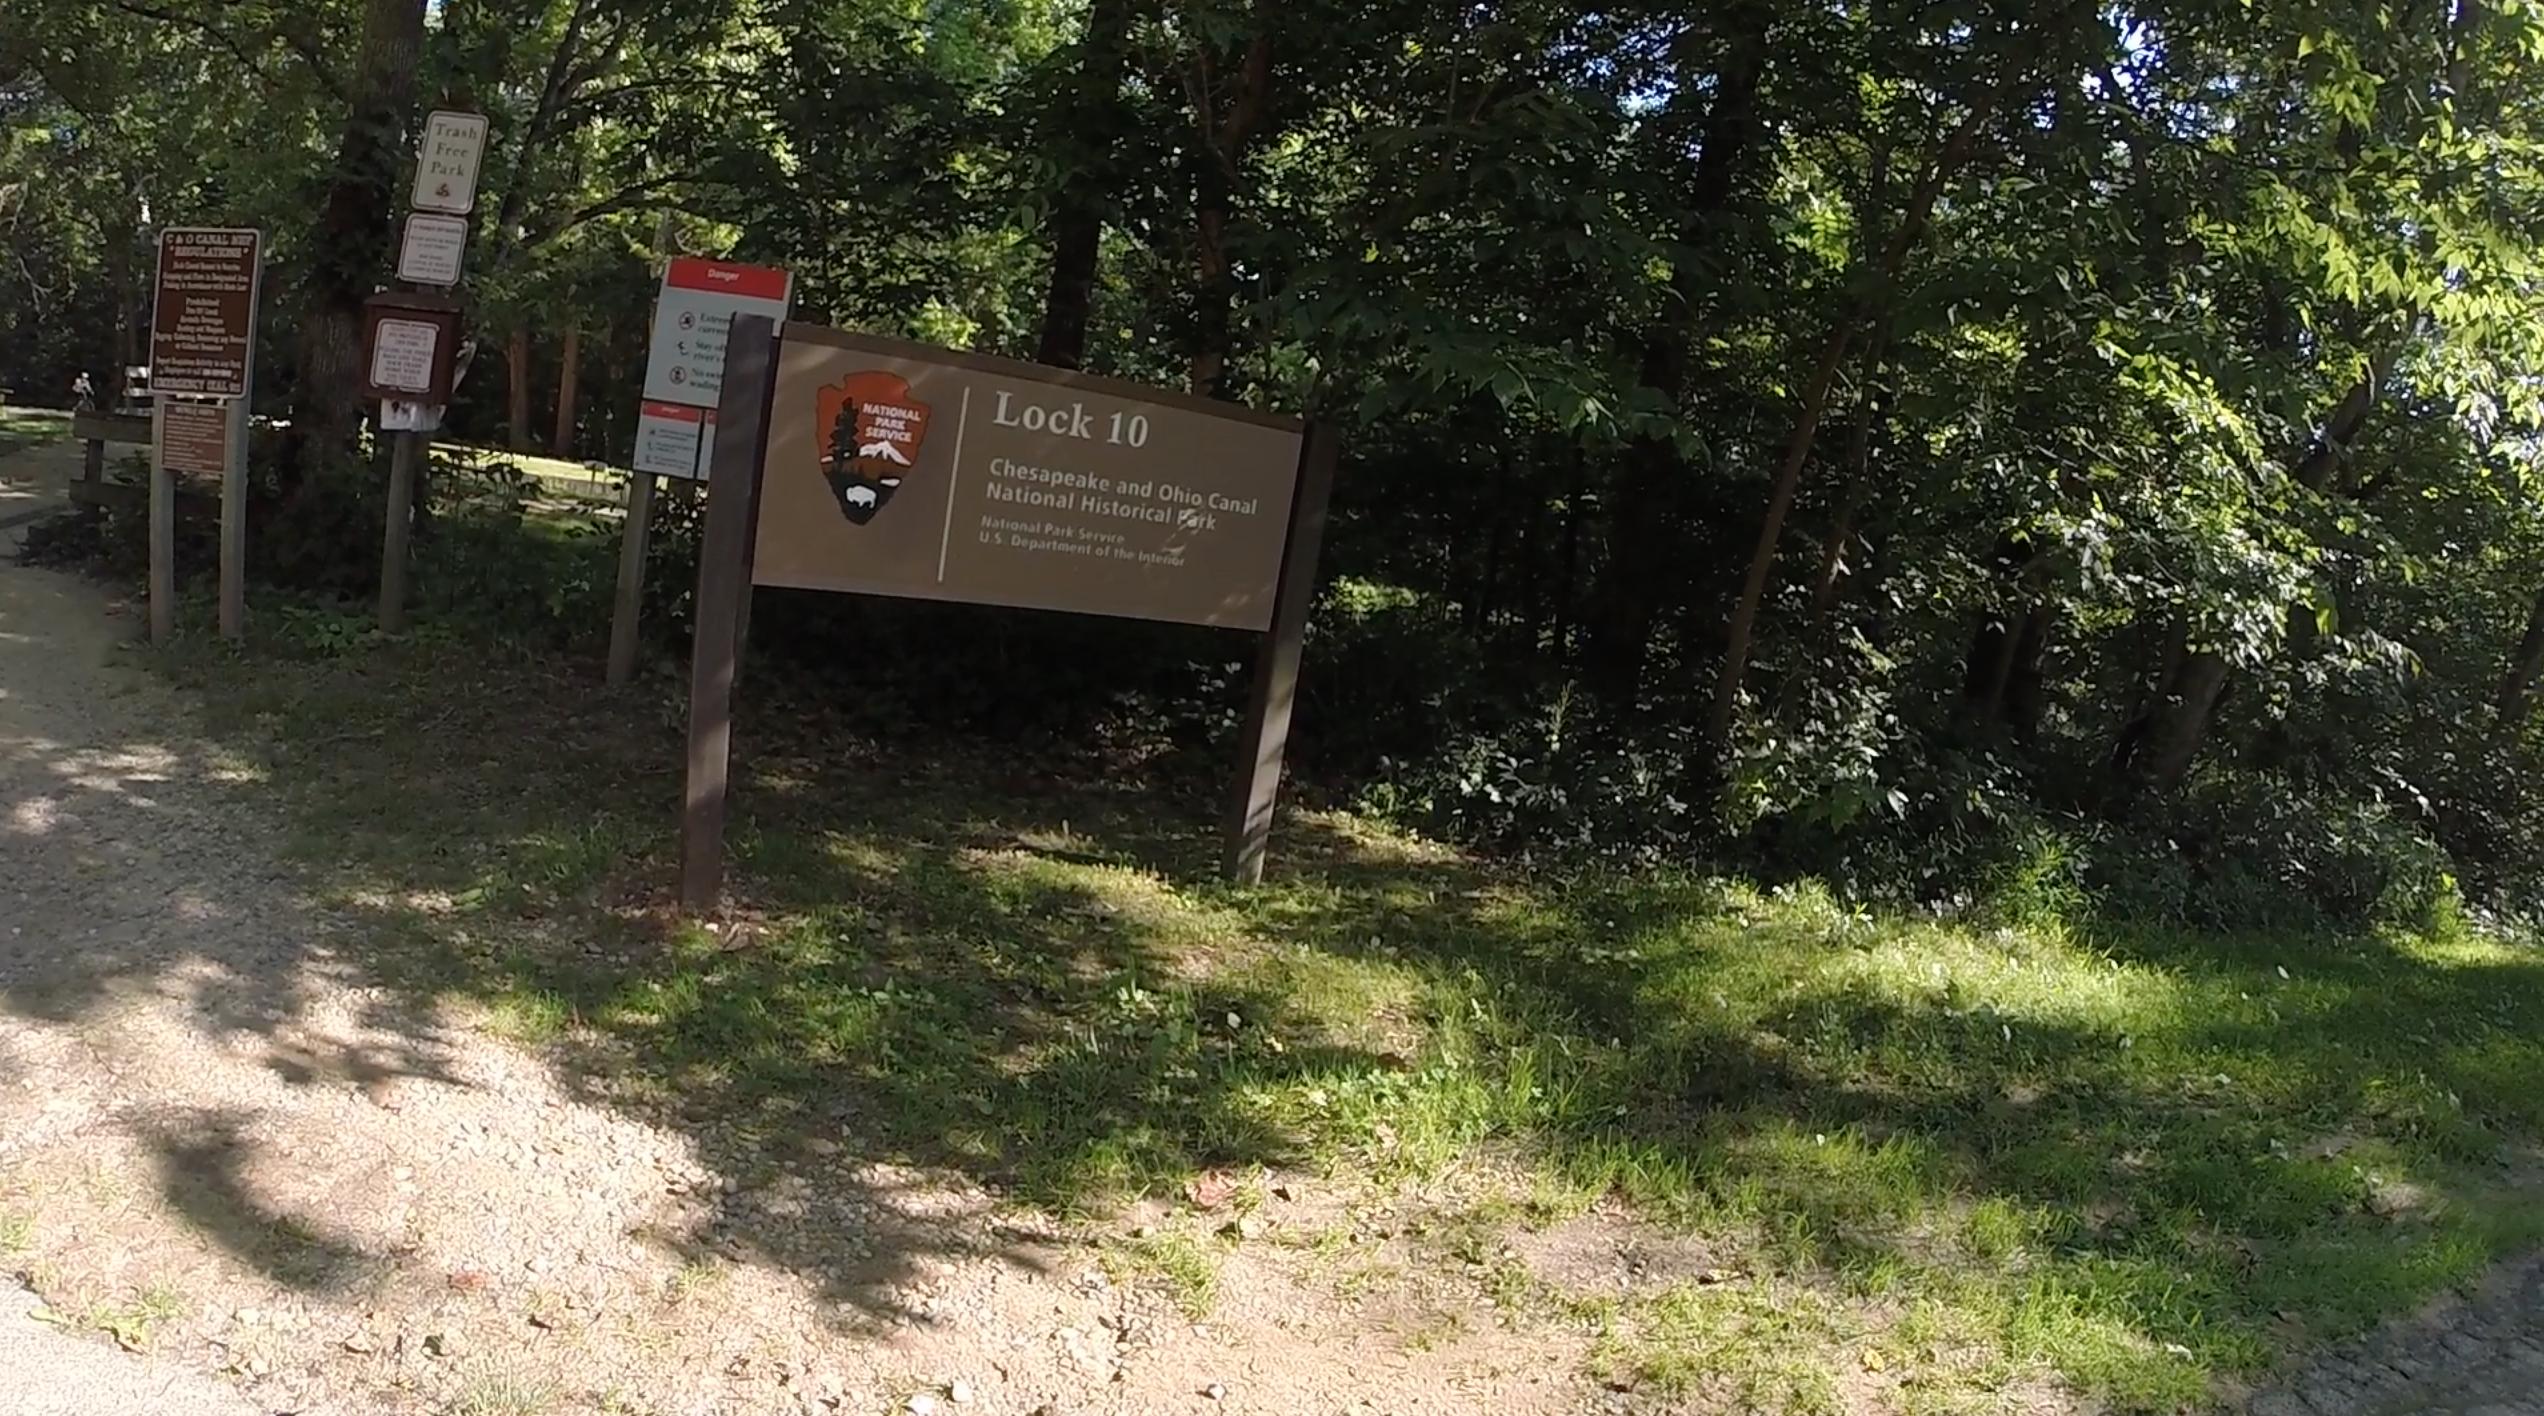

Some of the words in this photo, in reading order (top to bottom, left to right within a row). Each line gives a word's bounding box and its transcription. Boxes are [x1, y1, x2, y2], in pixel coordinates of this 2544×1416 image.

[434, 123, 477, 139] Trash
[436, 142, 469, 158] Free
[431, 161, 464, 176] Park
[166, 234, 175, 244] C
[185, 234, 195, 244] O
[707, 268, 740, 282] Danger
[863, 403, 921, 421] NATIONAL
[993, 390, 1094, 439] Lock
[1106, 411, 1149, 448] 10
[875, 416, 906, 430] PARK
[865, 426, 912, 442] SERVICE
[989, 458, 1110, 492] Chesapeake
[1116, 480, 1153, 498] and
[1158, 483, 1202, 506] Ohio
[1208, 492, 1258, 515] Canal
[986, 481, 1075, 510] National
[1080, 495, 1172, 524] Historical
[1177, 508, 1217, 530] Park
[981, 515, 1041, 534] National
[1044, 522, 1074, 538] Park
[1079, 527, 1125, 545] Service
[1011, 534, 1092, 555] Department
[1095, 545, 1111, 557] of
[1113, 548, 1135, 560] the
[1138, 550, 1186, 567] Interior
